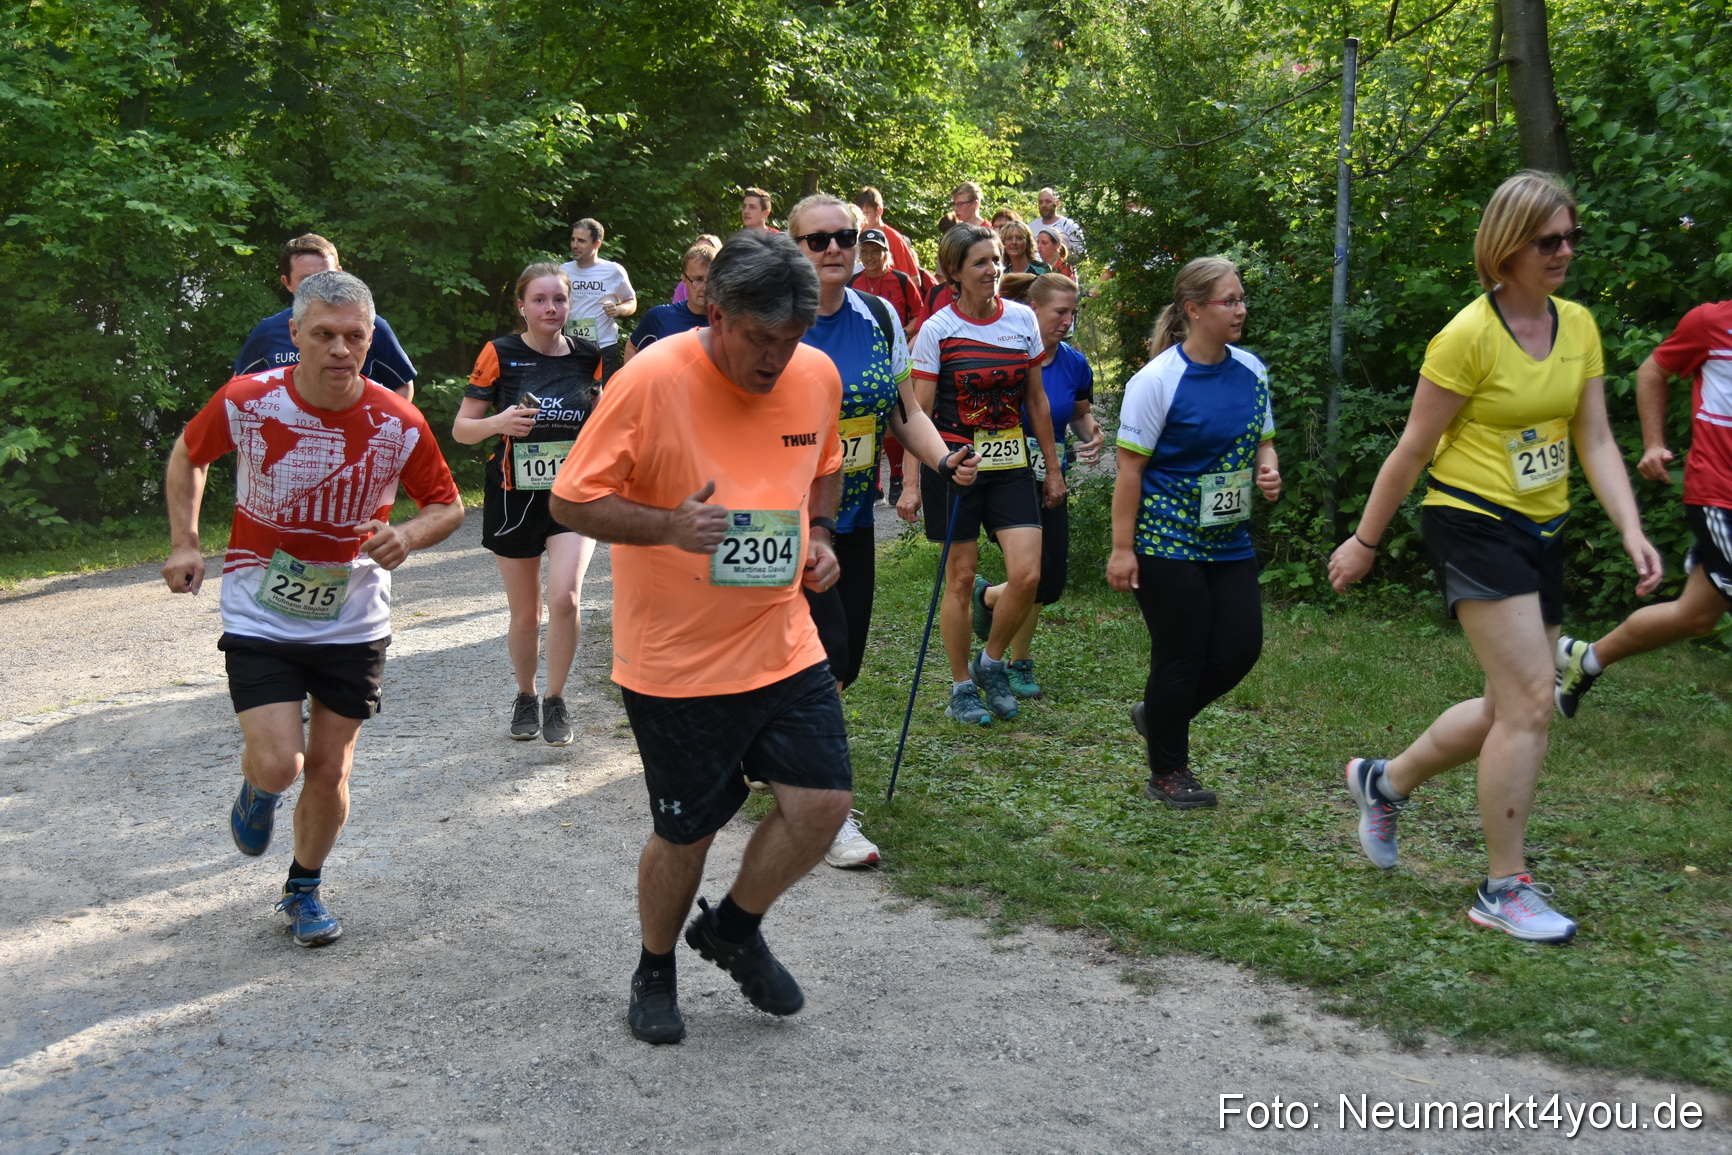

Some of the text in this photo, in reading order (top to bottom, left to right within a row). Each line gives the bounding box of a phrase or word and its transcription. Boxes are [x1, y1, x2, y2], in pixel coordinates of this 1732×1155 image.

[572, 281, 606, 292] GRADL
[573, 328, 590, 337] 942
[295, 418, 321, 429] 10.54
[782, 433, 817, 447] THULE
[981, 440, 1020, 458] 2253
[1518, 440, 1566, 476] 2198
[1212, 490, 1241, 510] 231
[722, 537, 793, 565] 2304
[271, 574, 338, 607] 2215
[272, 593, 329, 613] Hofmann Stephan
